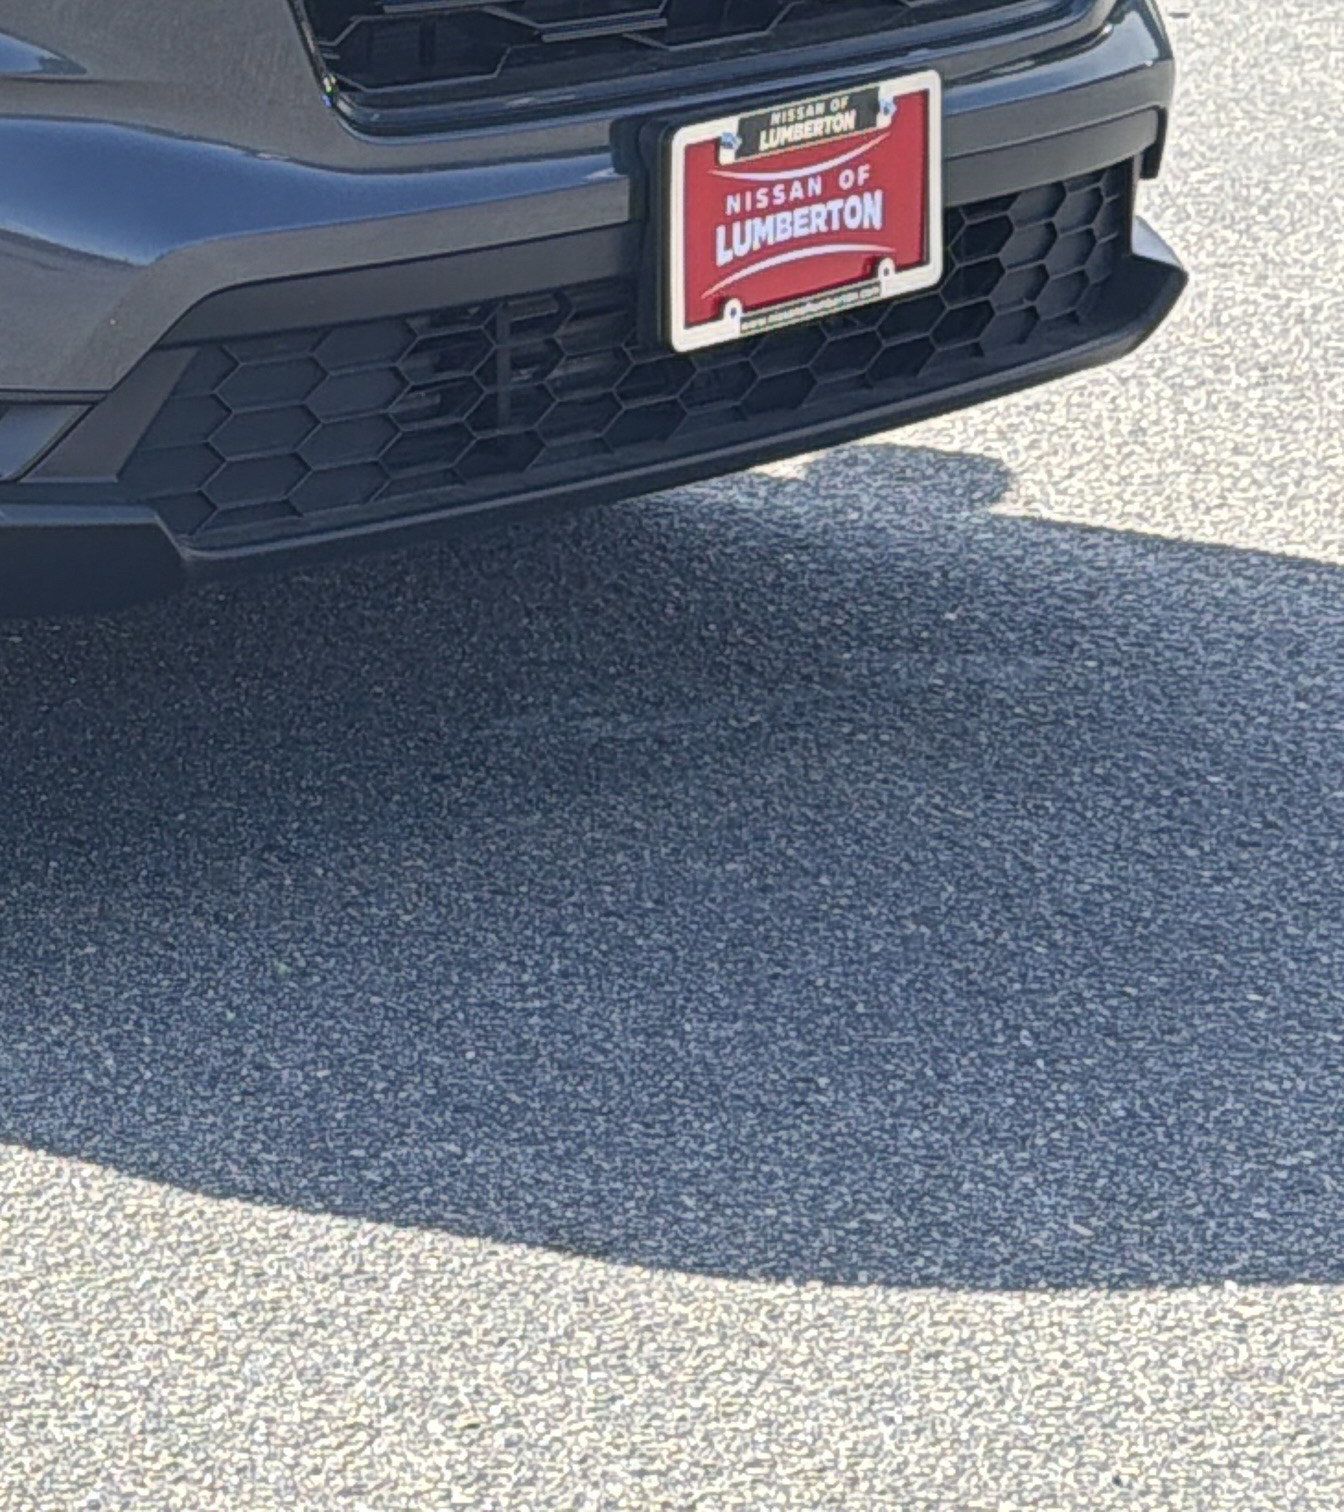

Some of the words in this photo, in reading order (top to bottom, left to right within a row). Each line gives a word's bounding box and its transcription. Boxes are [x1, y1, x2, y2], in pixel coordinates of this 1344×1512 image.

[758, 109, 857, 152] LUMBERTON
[770, 101, 825, 126] NISSAN
[830, 95, 850, 113] OF
[725, 175, 822, 216] NISSAN
[838, 164, 871, 190] OF
[715, 189, 883, 267] LUMBERTON
